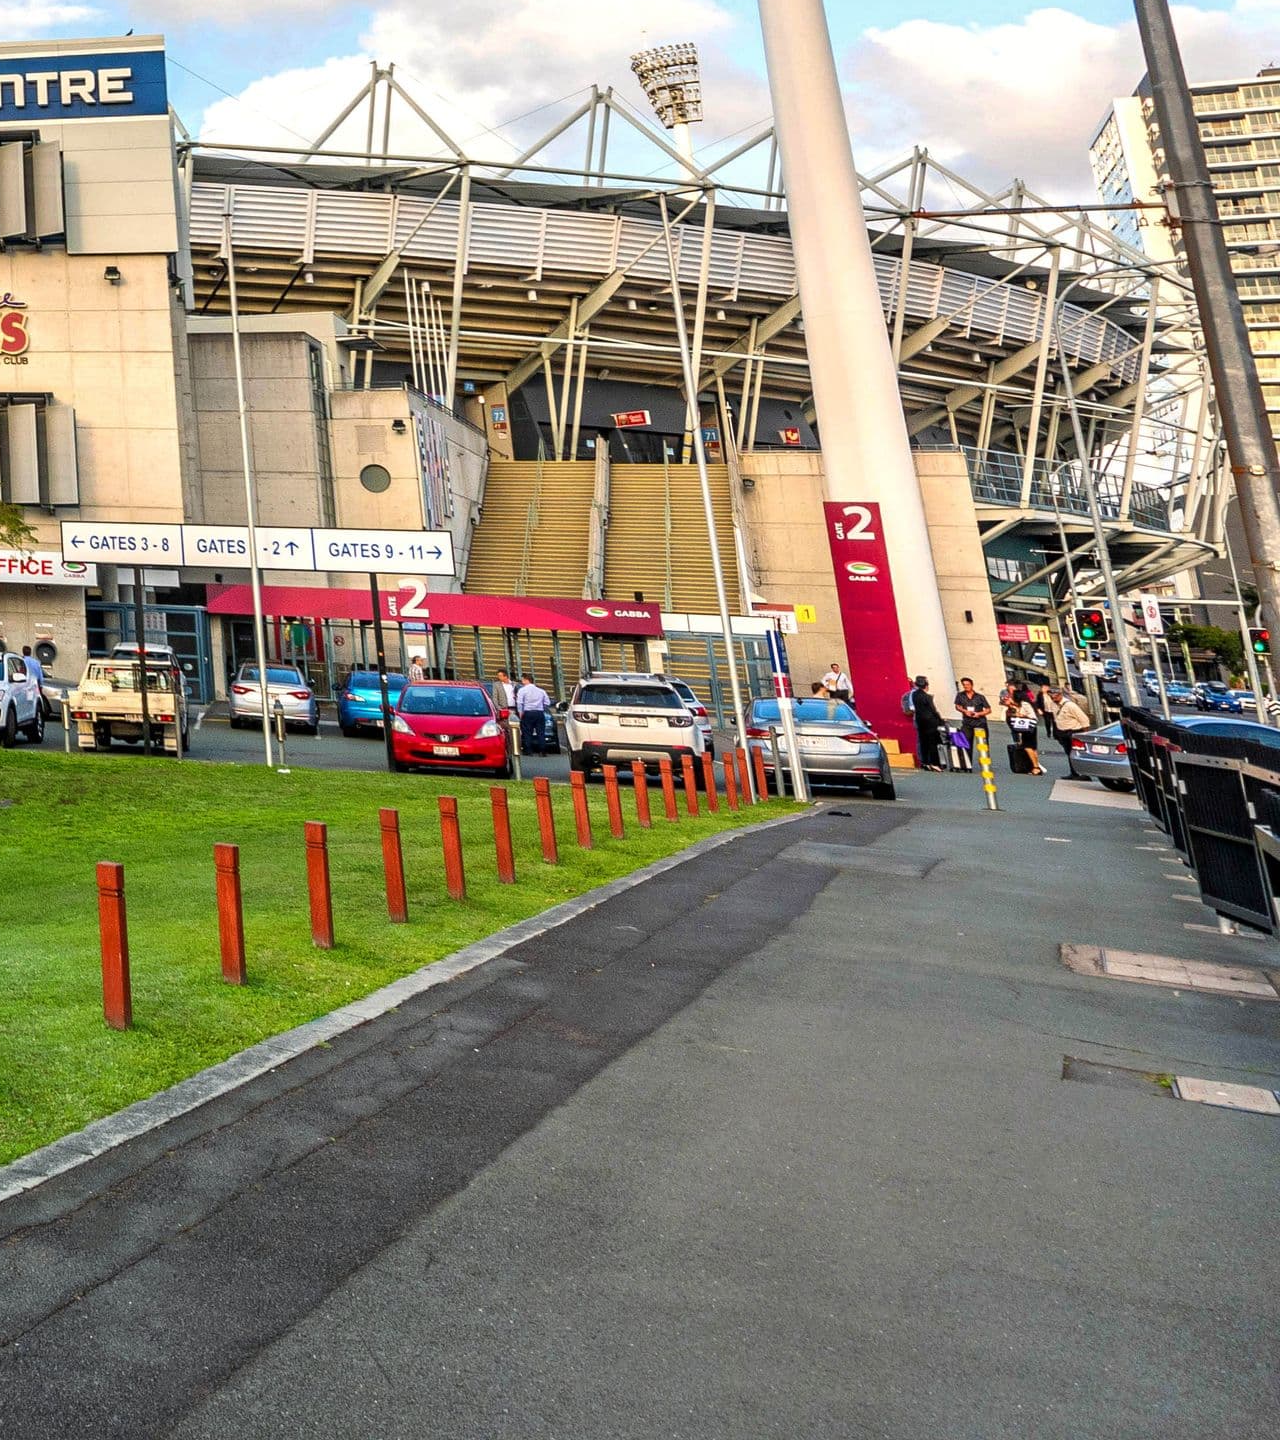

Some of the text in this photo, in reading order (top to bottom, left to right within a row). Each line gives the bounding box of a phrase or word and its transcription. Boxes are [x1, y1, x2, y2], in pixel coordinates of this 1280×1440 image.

[3, 356, 29, 365] CLUB
[493, 411, 505, 421] 72
[704, 431, 716, 441] 71
[841, 505, 876, 540] 2
[89, 535, 137, 551] GATES
[141, 537, 149, 551] 3
[161, 537, 170, 552] 8
[196, 538, 246, 554] GATES
[272, 541, 280, 555] 2
[328, 542, 381, 558] GATES
[385, 544, 393, 559] 9
[408, 544, 423, 559] 11
[397, 578, 430, 619] 2
[614, 609, 651, 619] GABBA
[1033, 628, 1047, 641] 11
